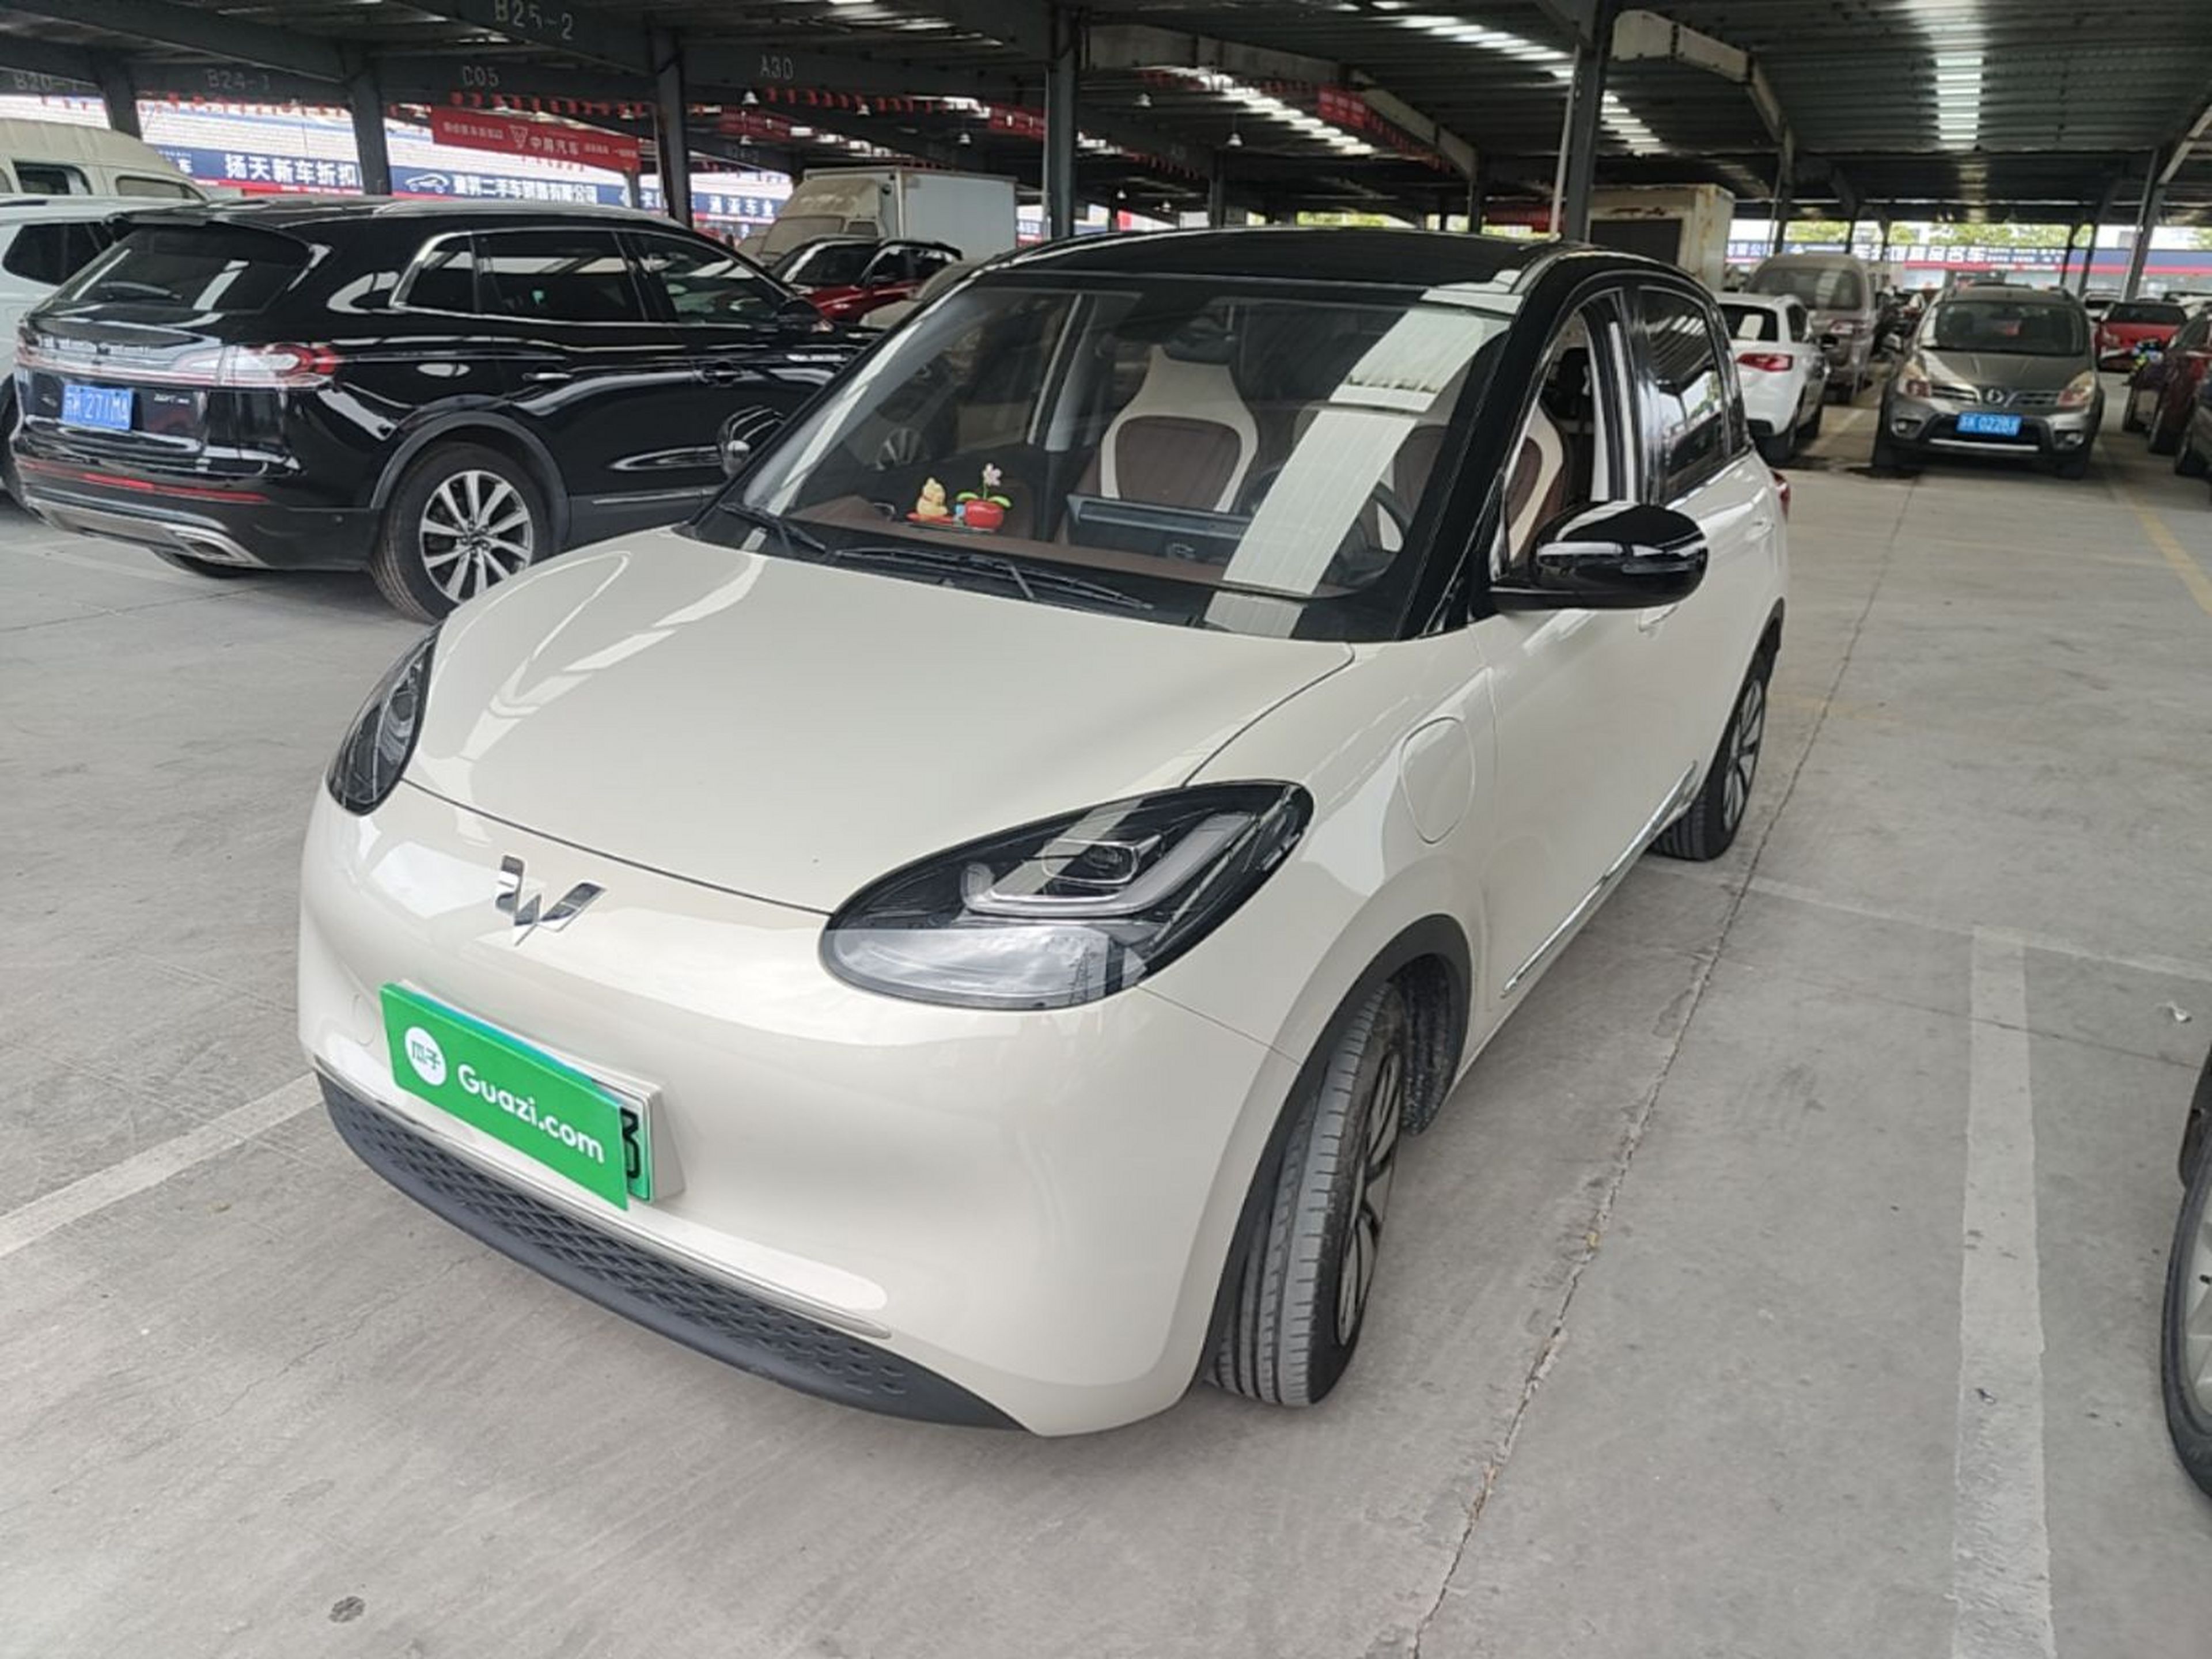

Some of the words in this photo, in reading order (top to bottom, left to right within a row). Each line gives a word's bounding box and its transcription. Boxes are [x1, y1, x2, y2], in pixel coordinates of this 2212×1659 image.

[495, 0, 574, 40] B25-2
[760, 54, 793, 80] A30
[224, 153, 362, 188] 扬天新车折扣
[457, 1063, 605, 1164] Guazi.com
